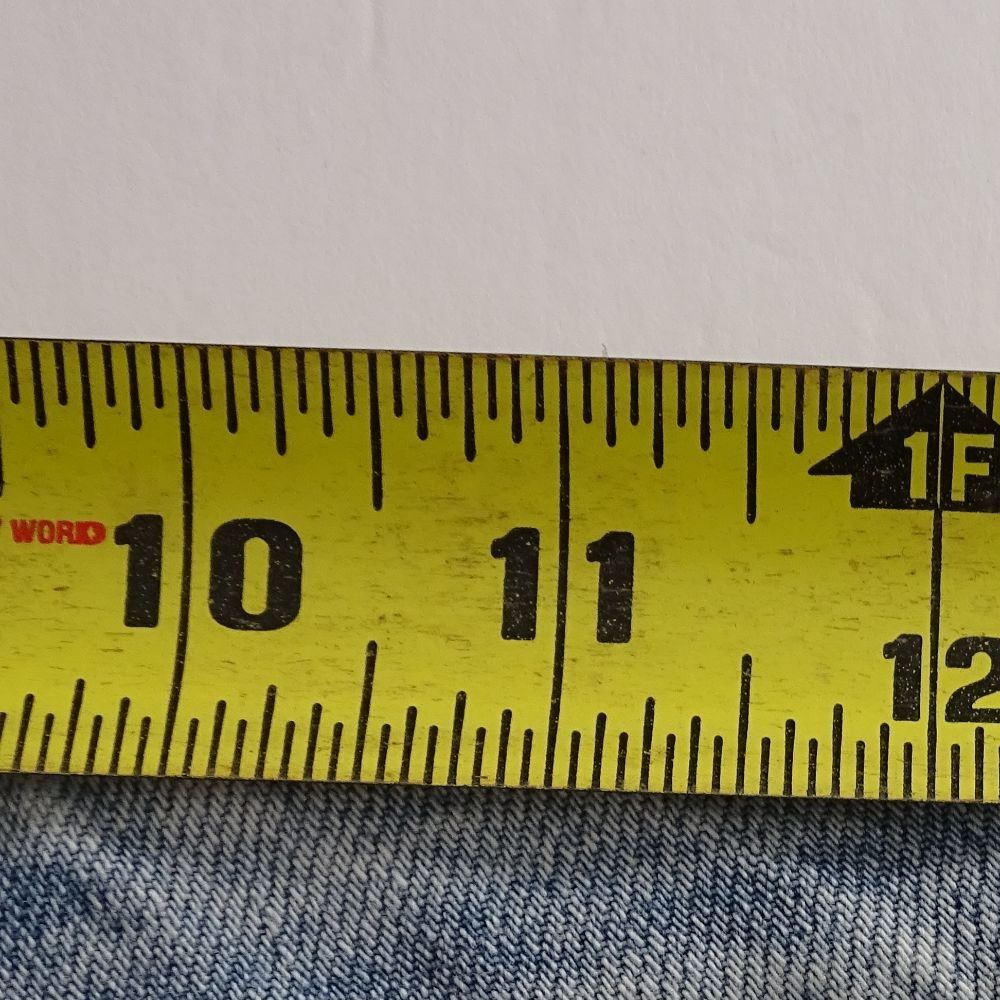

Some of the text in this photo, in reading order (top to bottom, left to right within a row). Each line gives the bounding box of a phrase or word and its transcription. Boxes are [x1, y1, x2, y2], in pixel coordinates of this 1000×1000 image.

[903, 430, 994, 501] 1F
[114, 513, 302, 631] 10
[491, 526, 635, 643] 11
